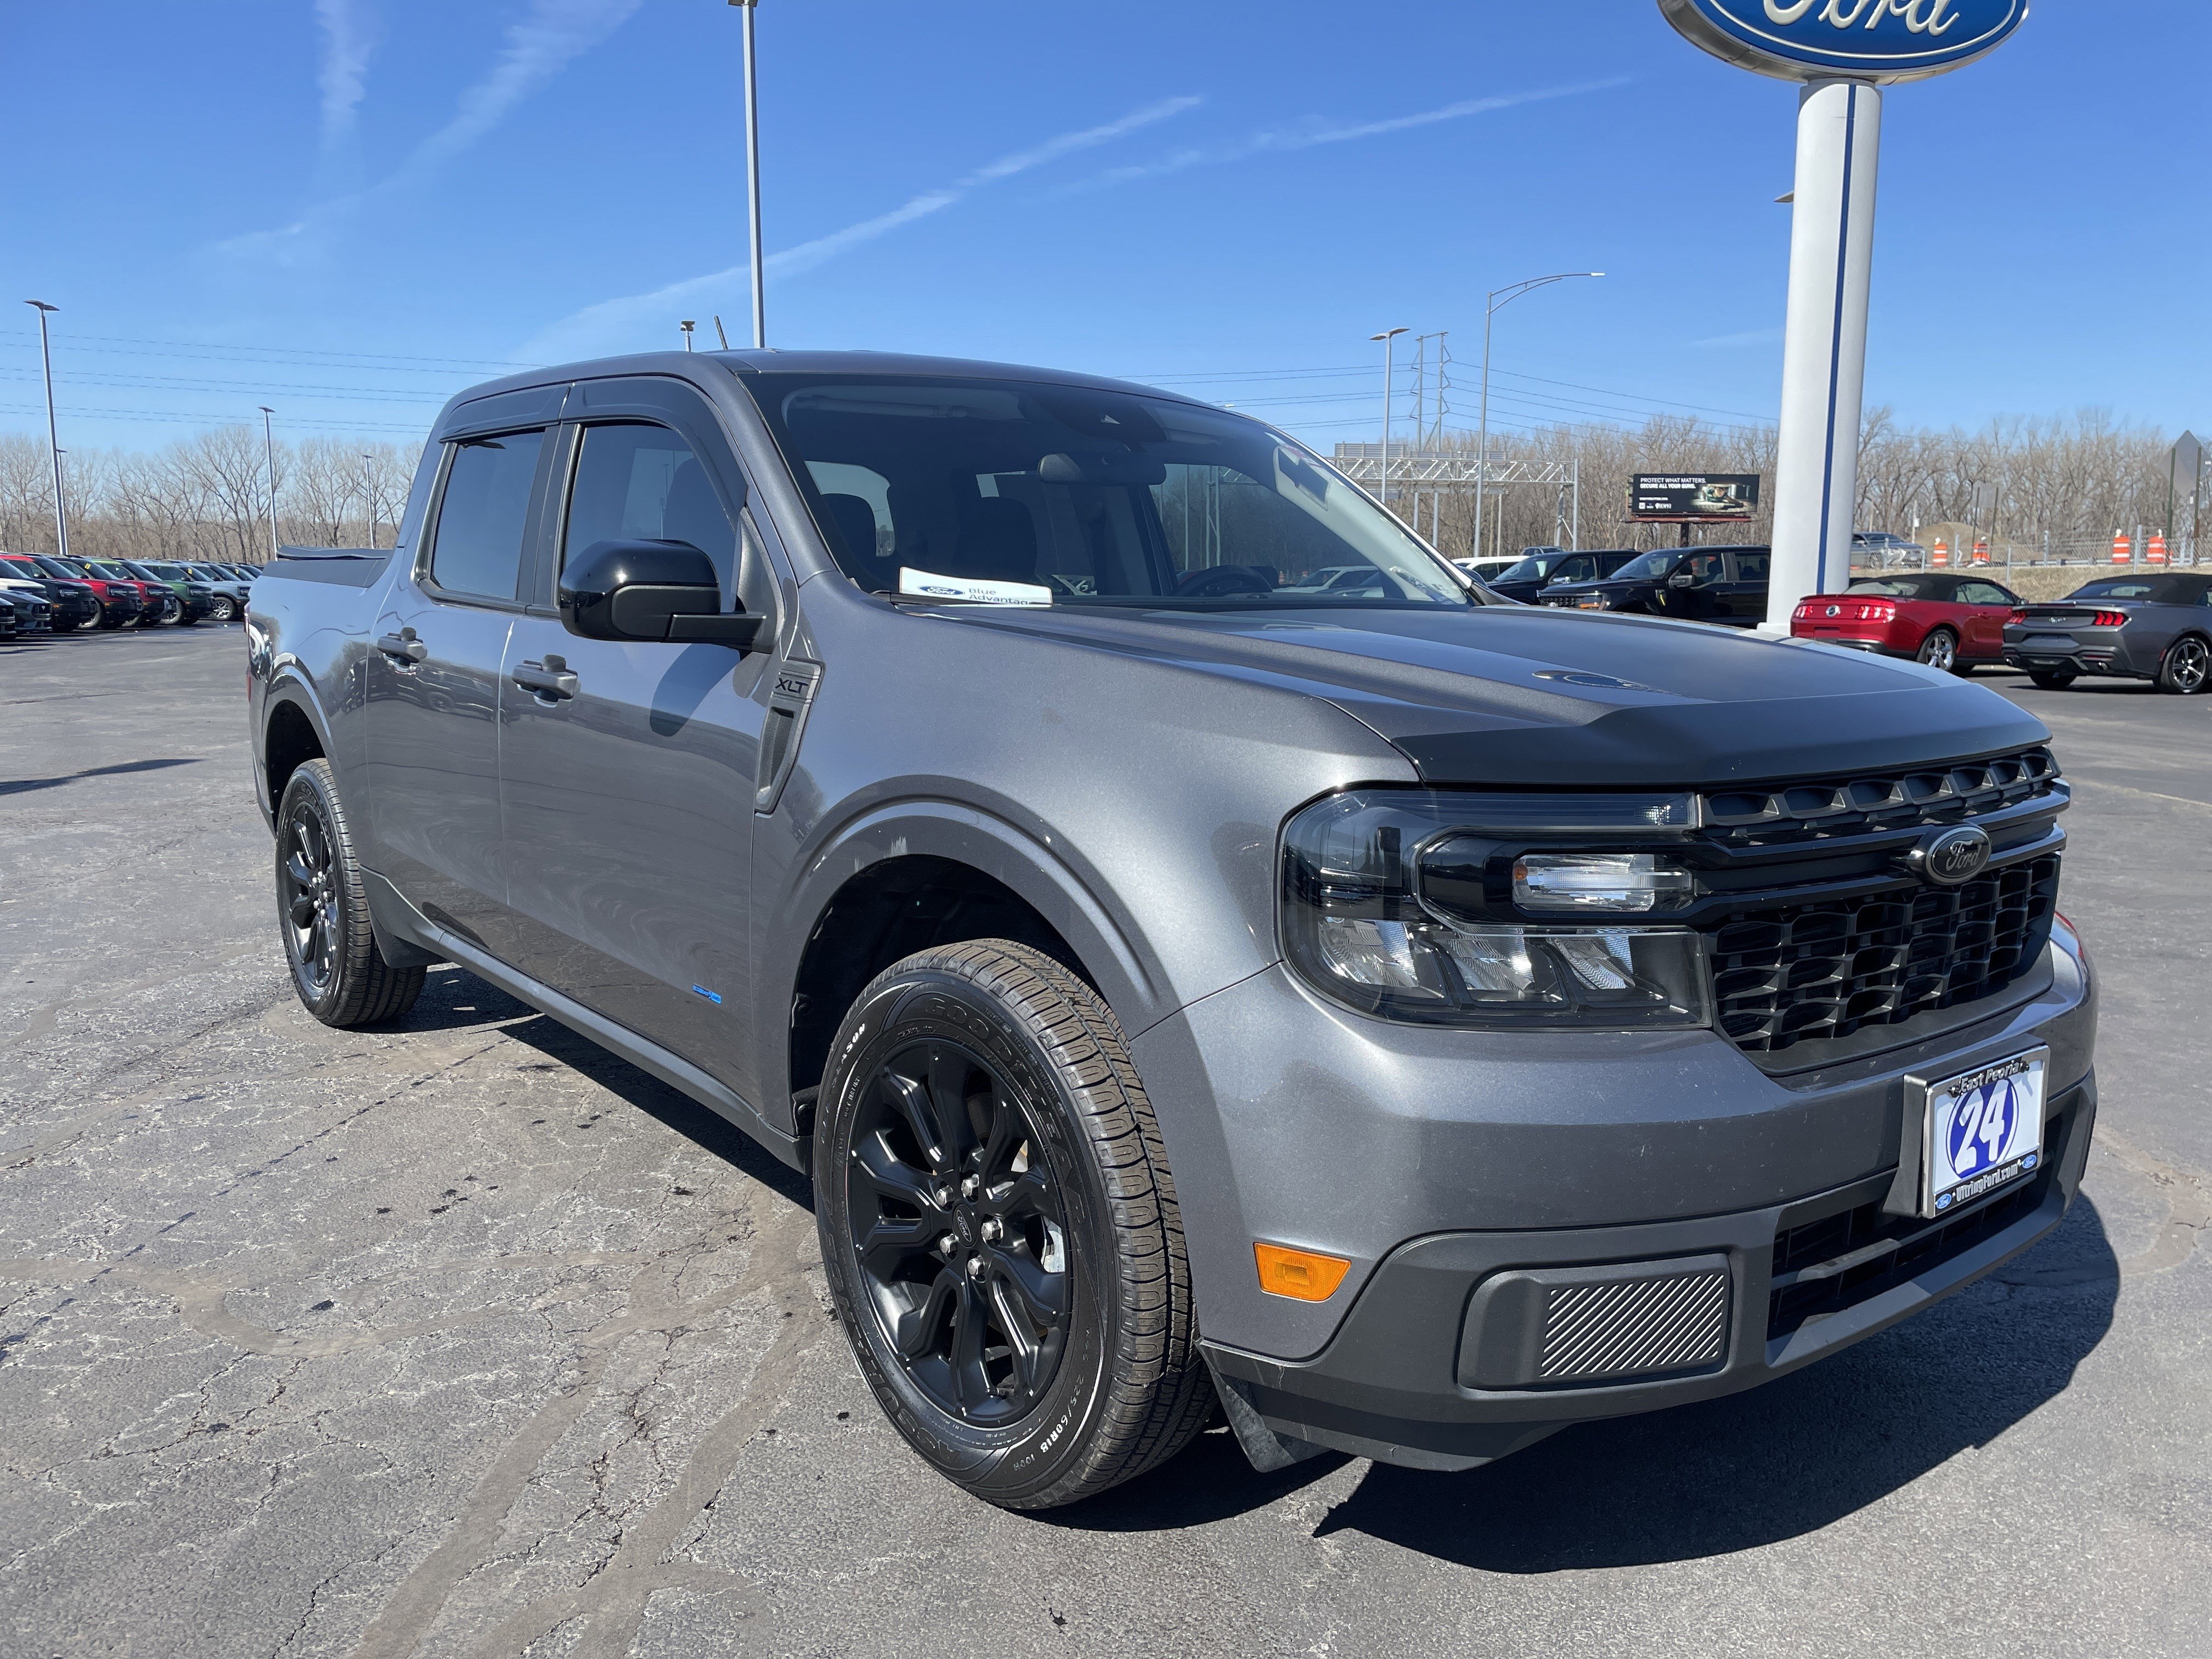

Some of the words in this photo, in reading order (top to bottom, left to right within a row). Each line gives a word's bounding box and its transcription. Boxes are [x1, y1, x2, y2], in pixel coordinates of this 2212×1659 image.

[1763, 0, 1960, 36] ord
[927, 586, 956, 595] Ford
[969, 594, 1034, 605] Advantag
[775, 678, 809, 694] XLT
[1945, 839, 1982, 871] Ford
[1959, 1073, 1985, 1093] East
[1985, 1060, 2020, 1084] Peoria
[925, 997, 1084, 1224] GOODYEAR
[1954, 1079, 2005, 1175] 24
[1956, 1164, 2018, 1202] UftringFord.com
[1040, 1373, 1084, 1453] 225/60R18
